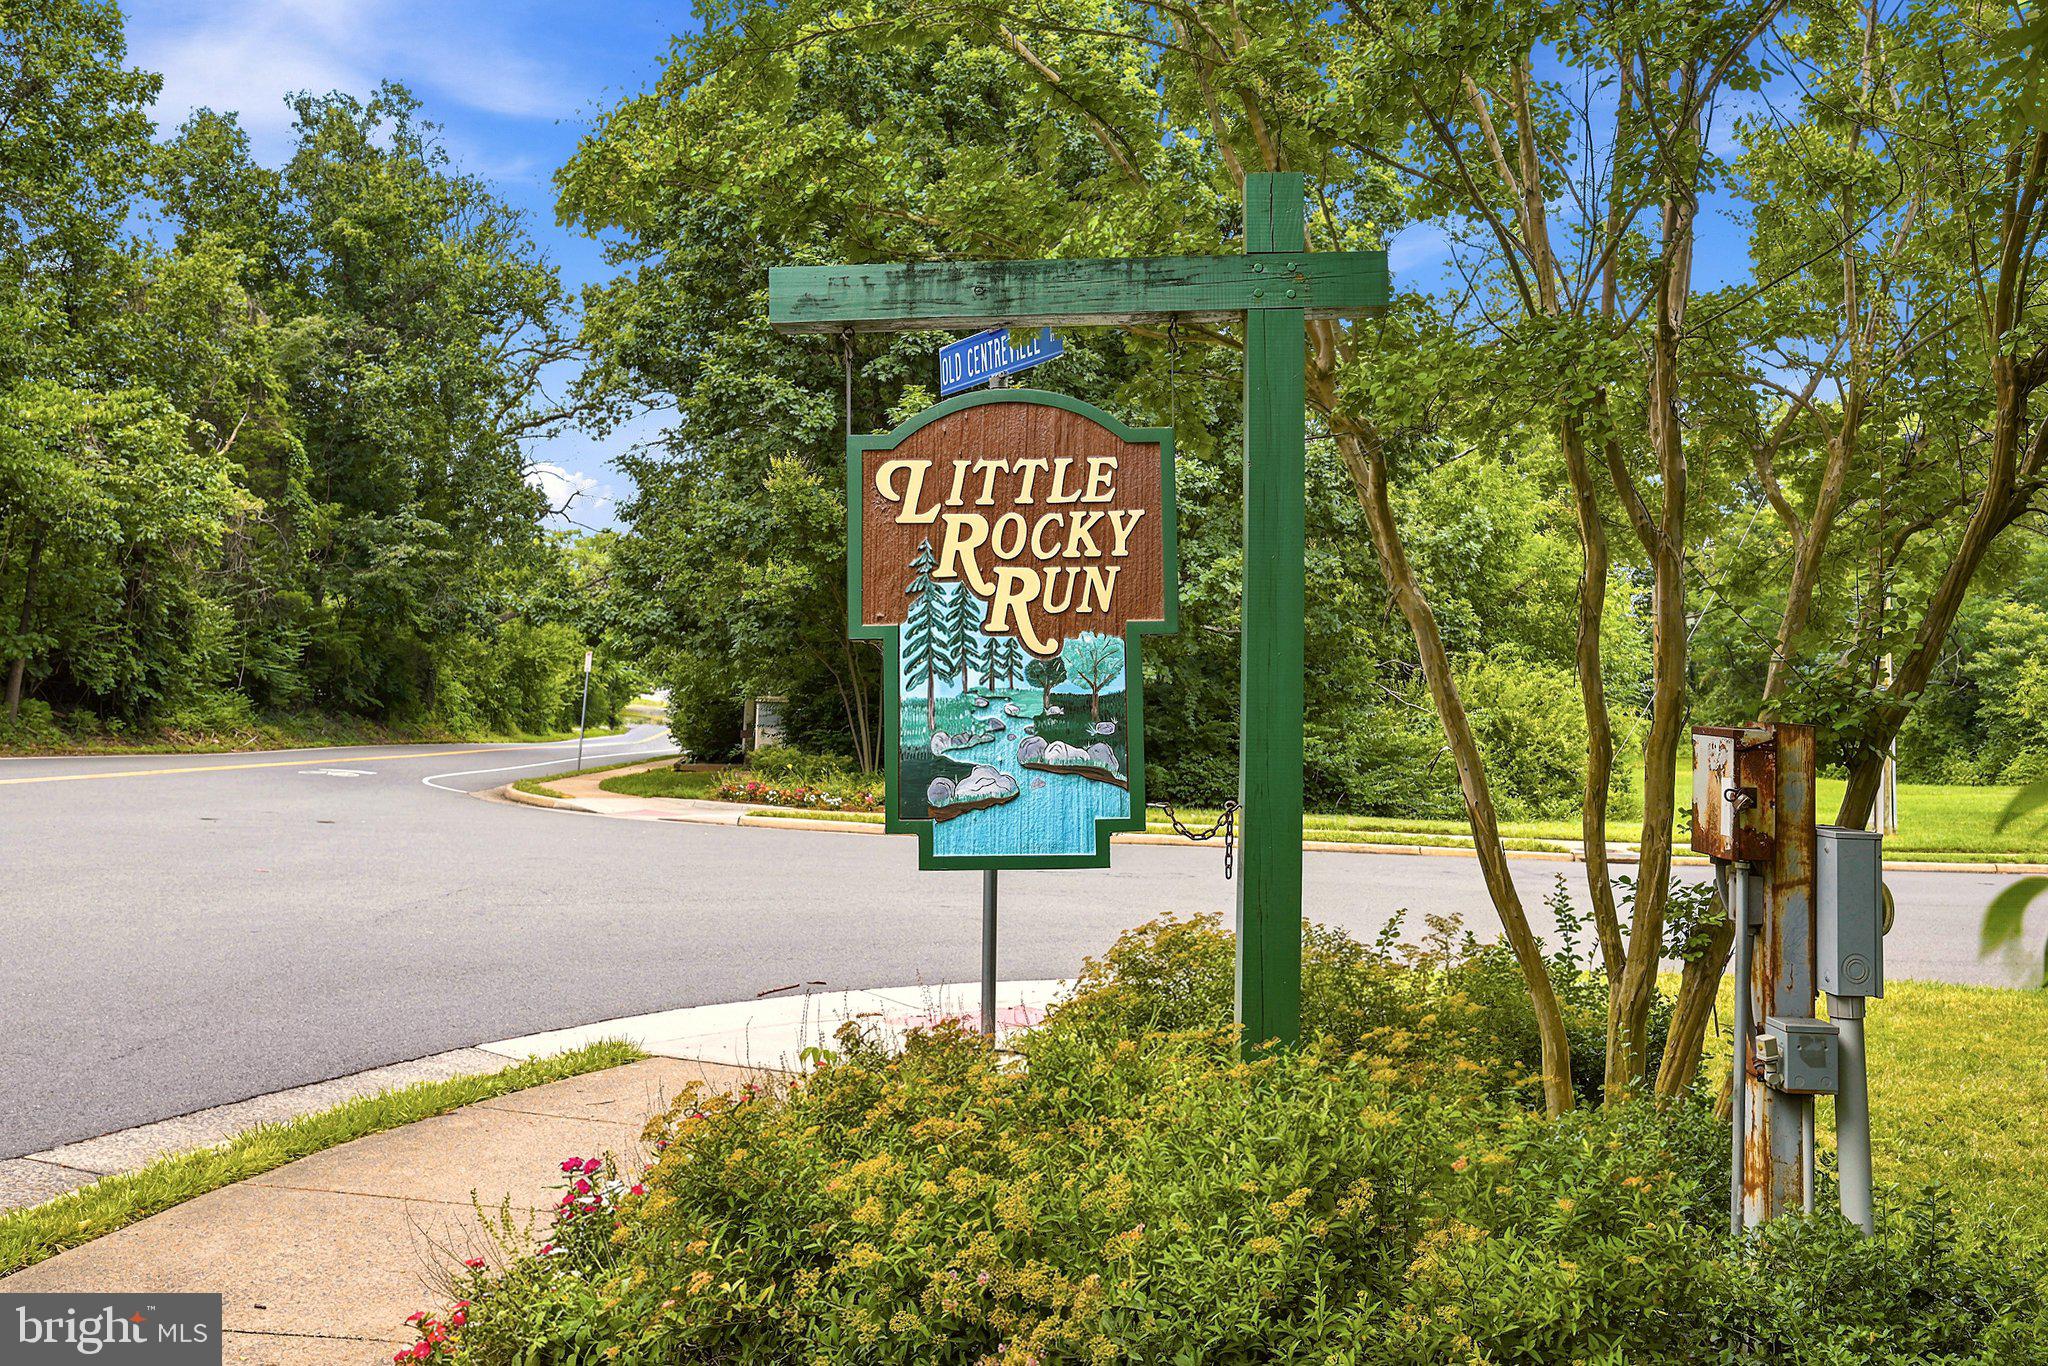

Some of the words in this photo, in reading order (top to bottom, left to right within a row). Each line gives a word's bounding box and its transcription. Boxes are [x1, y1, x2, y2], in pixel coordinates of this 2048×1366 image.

[942, 352, 962, 386] OLD
[875, 456, 1118, 525] LITTLE
[932, 509, 1146, 597] ROCKY
[984, 566, 1121, 656] RUN
